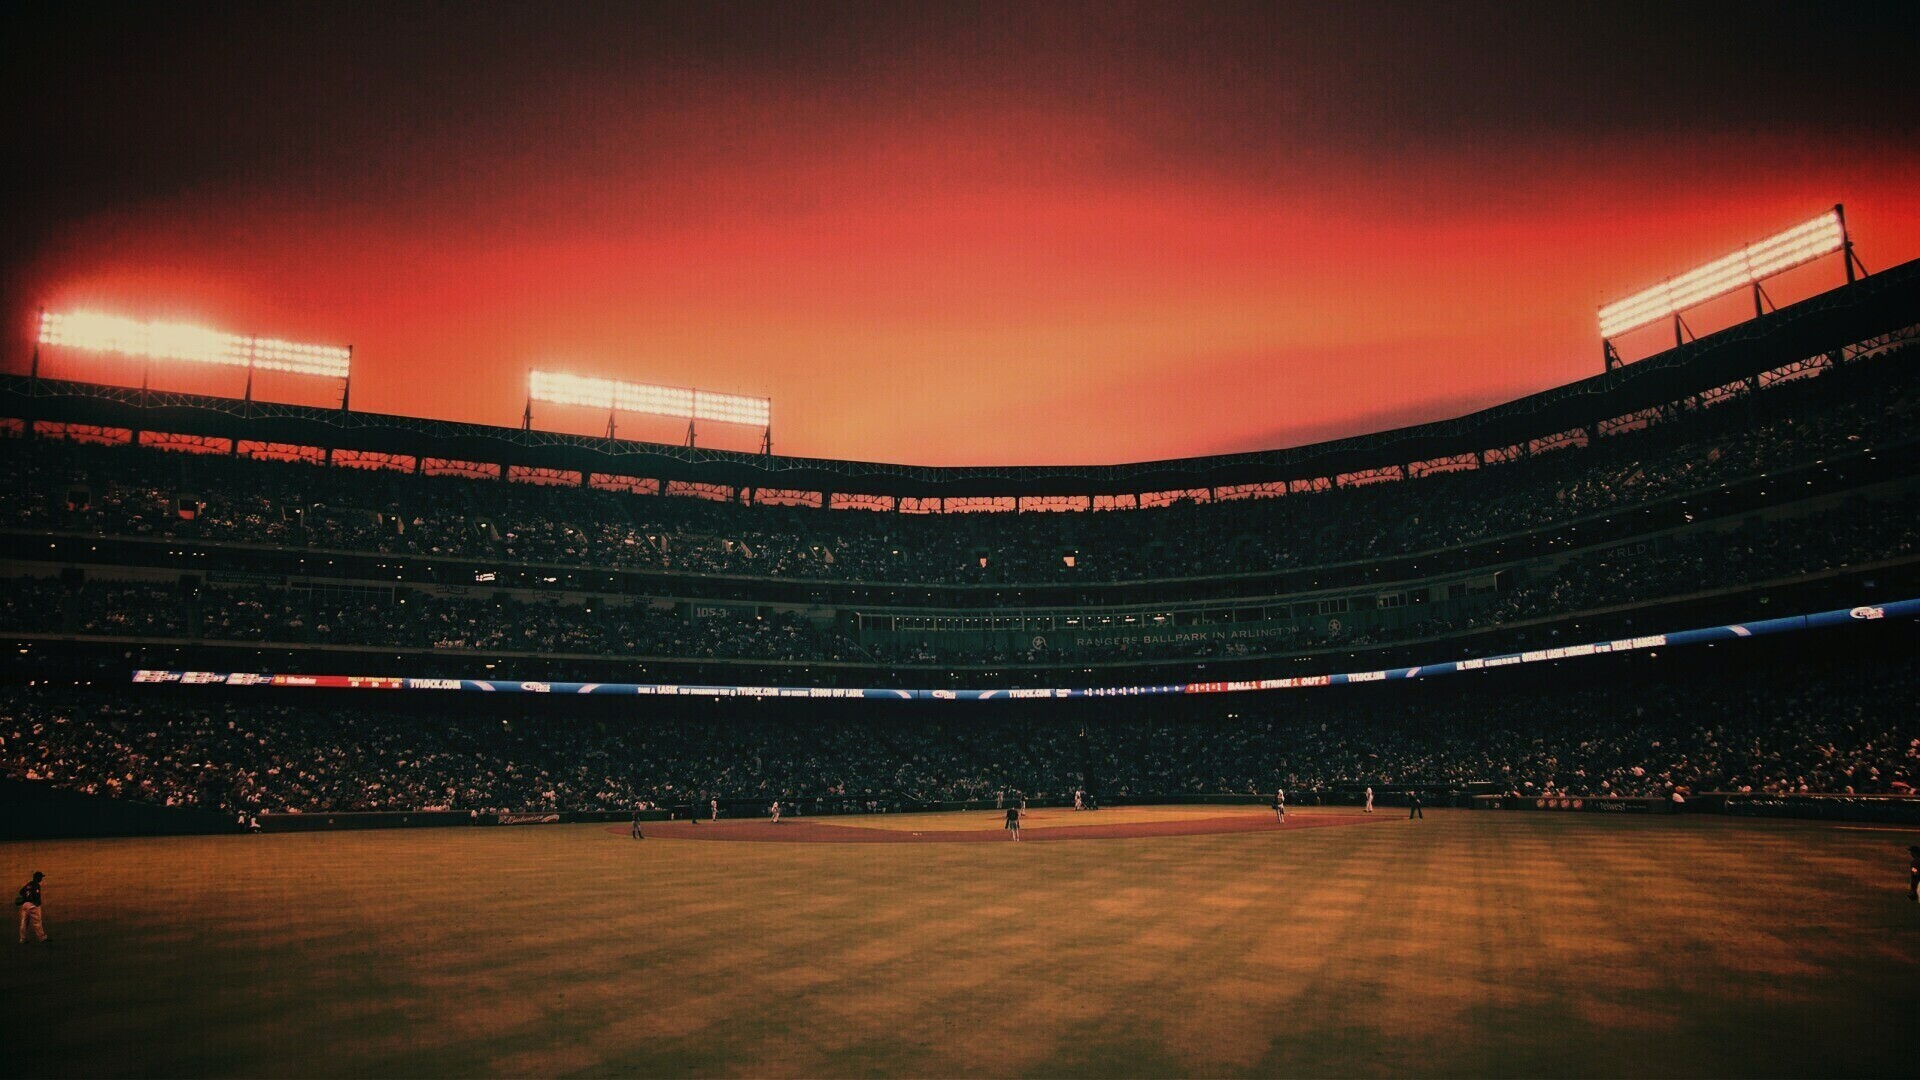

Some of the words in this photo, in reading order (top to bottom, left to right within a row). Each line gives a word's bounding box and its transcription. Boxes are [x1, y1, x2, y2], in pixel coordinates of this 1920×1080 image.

[1077, 636, 1138, 648] RANGERS
[1143, 632, 1208, 644] BALLPARK
[1212, 631, 1226, 640] IN
[1231, 626, 1300, 639] ARLINGTON
[1632, 634, 1666, 649] RANGERS
[410, 679, 461, 690] TYLOCK.COM
[1228, 681, 1251, 691] BALL
[1251, 681, 1257, 690] 1
[1260, 678, 1292, 689] STRIKE
[1292, 678, 1299, 687] 1
[1300, 677, 1321, 687] OUT
[1321, 676, 1328, 685] 2
[657, 685, 678, 694] LASIK
[737, 687, 779, 696] TYLOCK.COM
[833, 688, 845, 697] OFF
[1009, 689, 1051, 698] TYLOCK.COM
